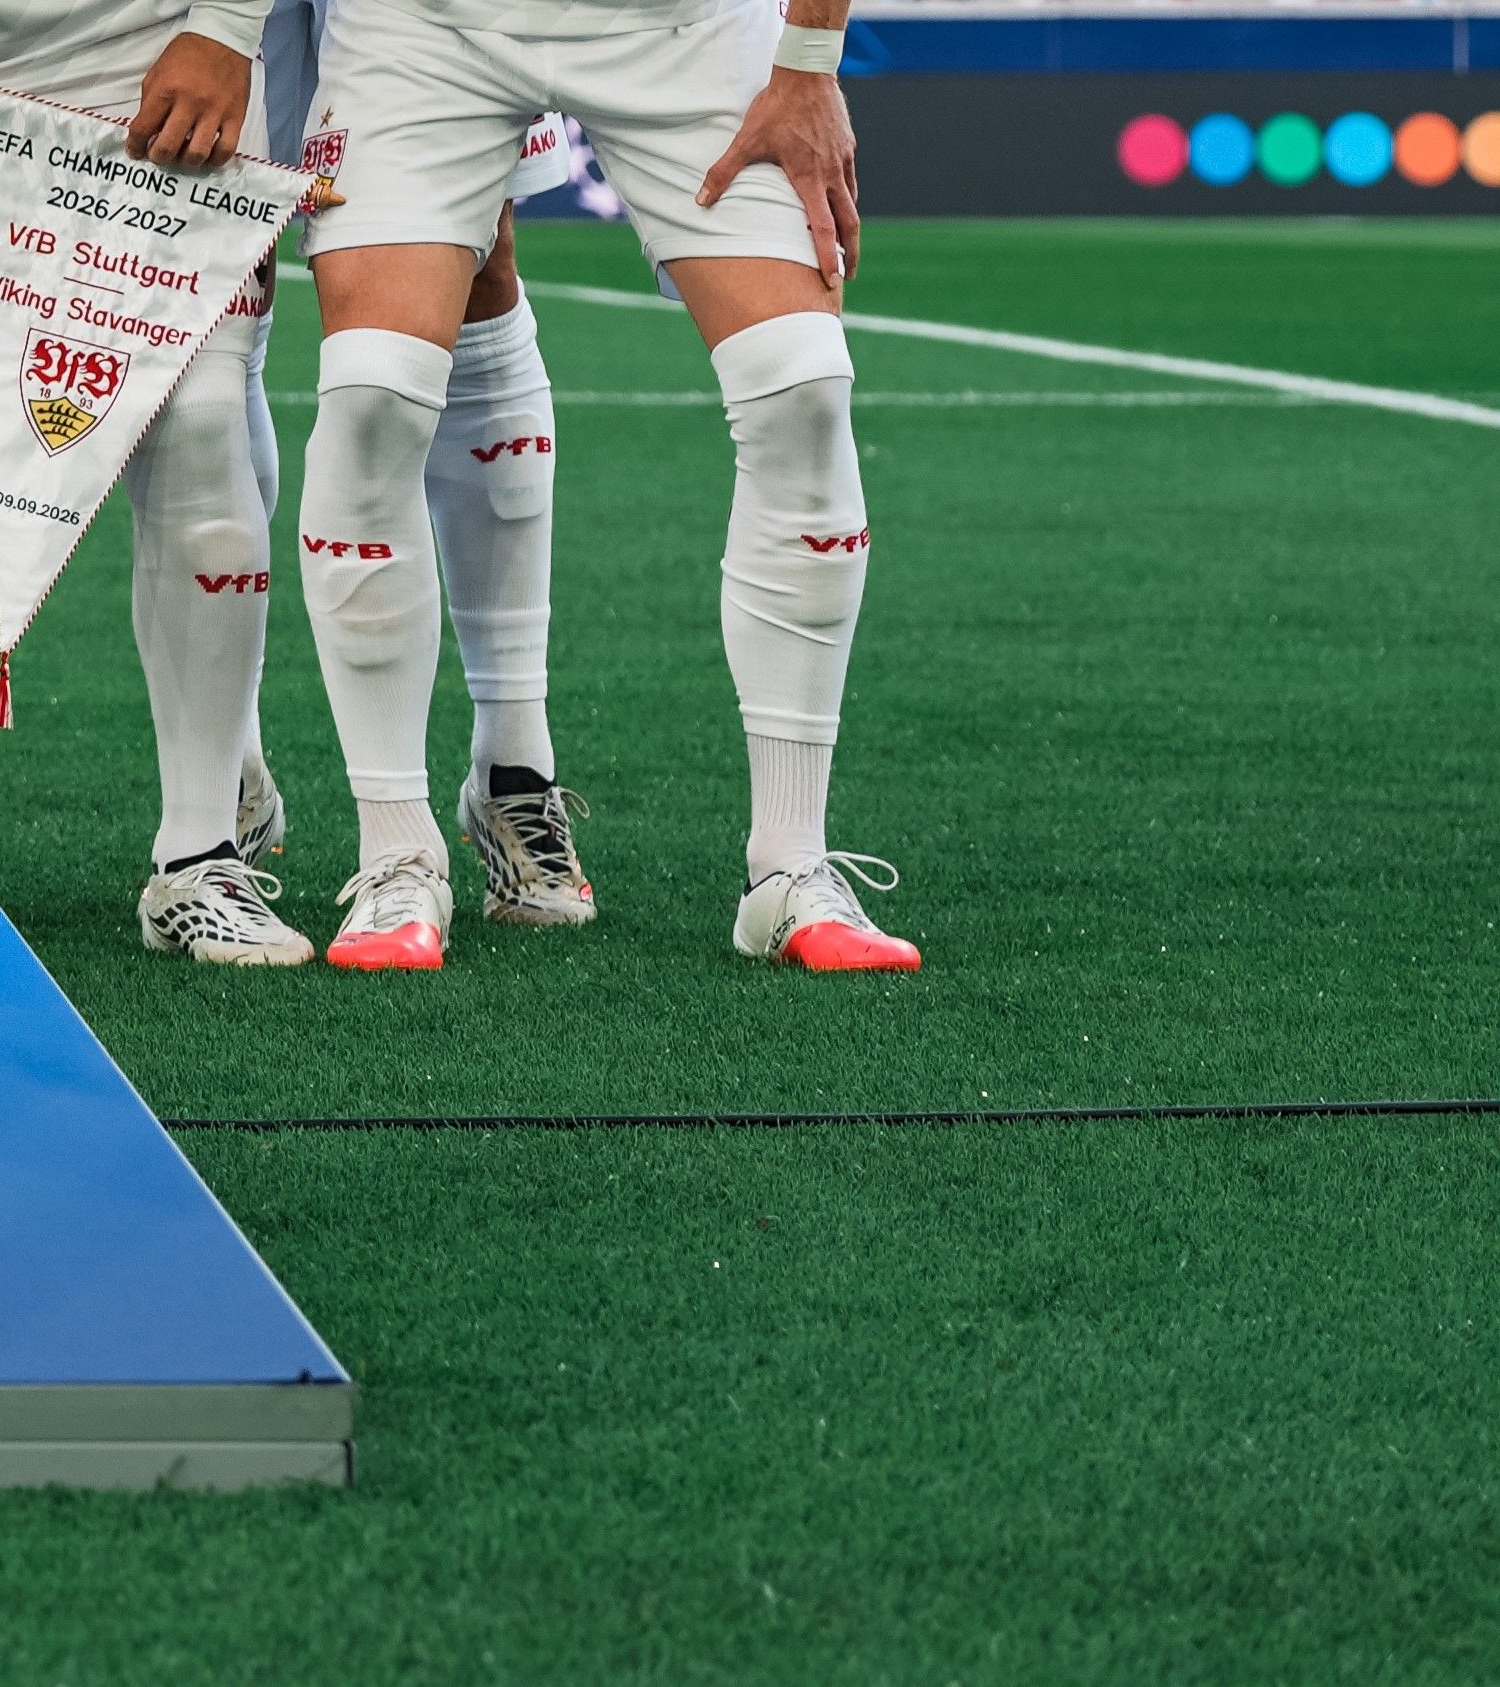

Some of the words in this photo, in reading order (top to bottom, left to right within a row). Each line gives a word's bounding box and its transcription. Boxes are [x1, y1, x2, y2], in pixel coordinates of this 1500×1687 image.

[48, 146, 178, 198] CHAMPIONS
[190, 183, 279, 224] LEAGUE
[47, 186, 187, 238] 2026/2027
[9, 221, 56, 255] VfB
[72, 241, 199, 295] Stuttgart
[67, 297, 192, 347] Stavanger
[39, 387, 51, 398] 18
[79, 397, 94, 410] 93
[470, 435, 552, 463] VfB
[302, 535, 393, 560] VfB
[194, 571, 270, 593] VfB
